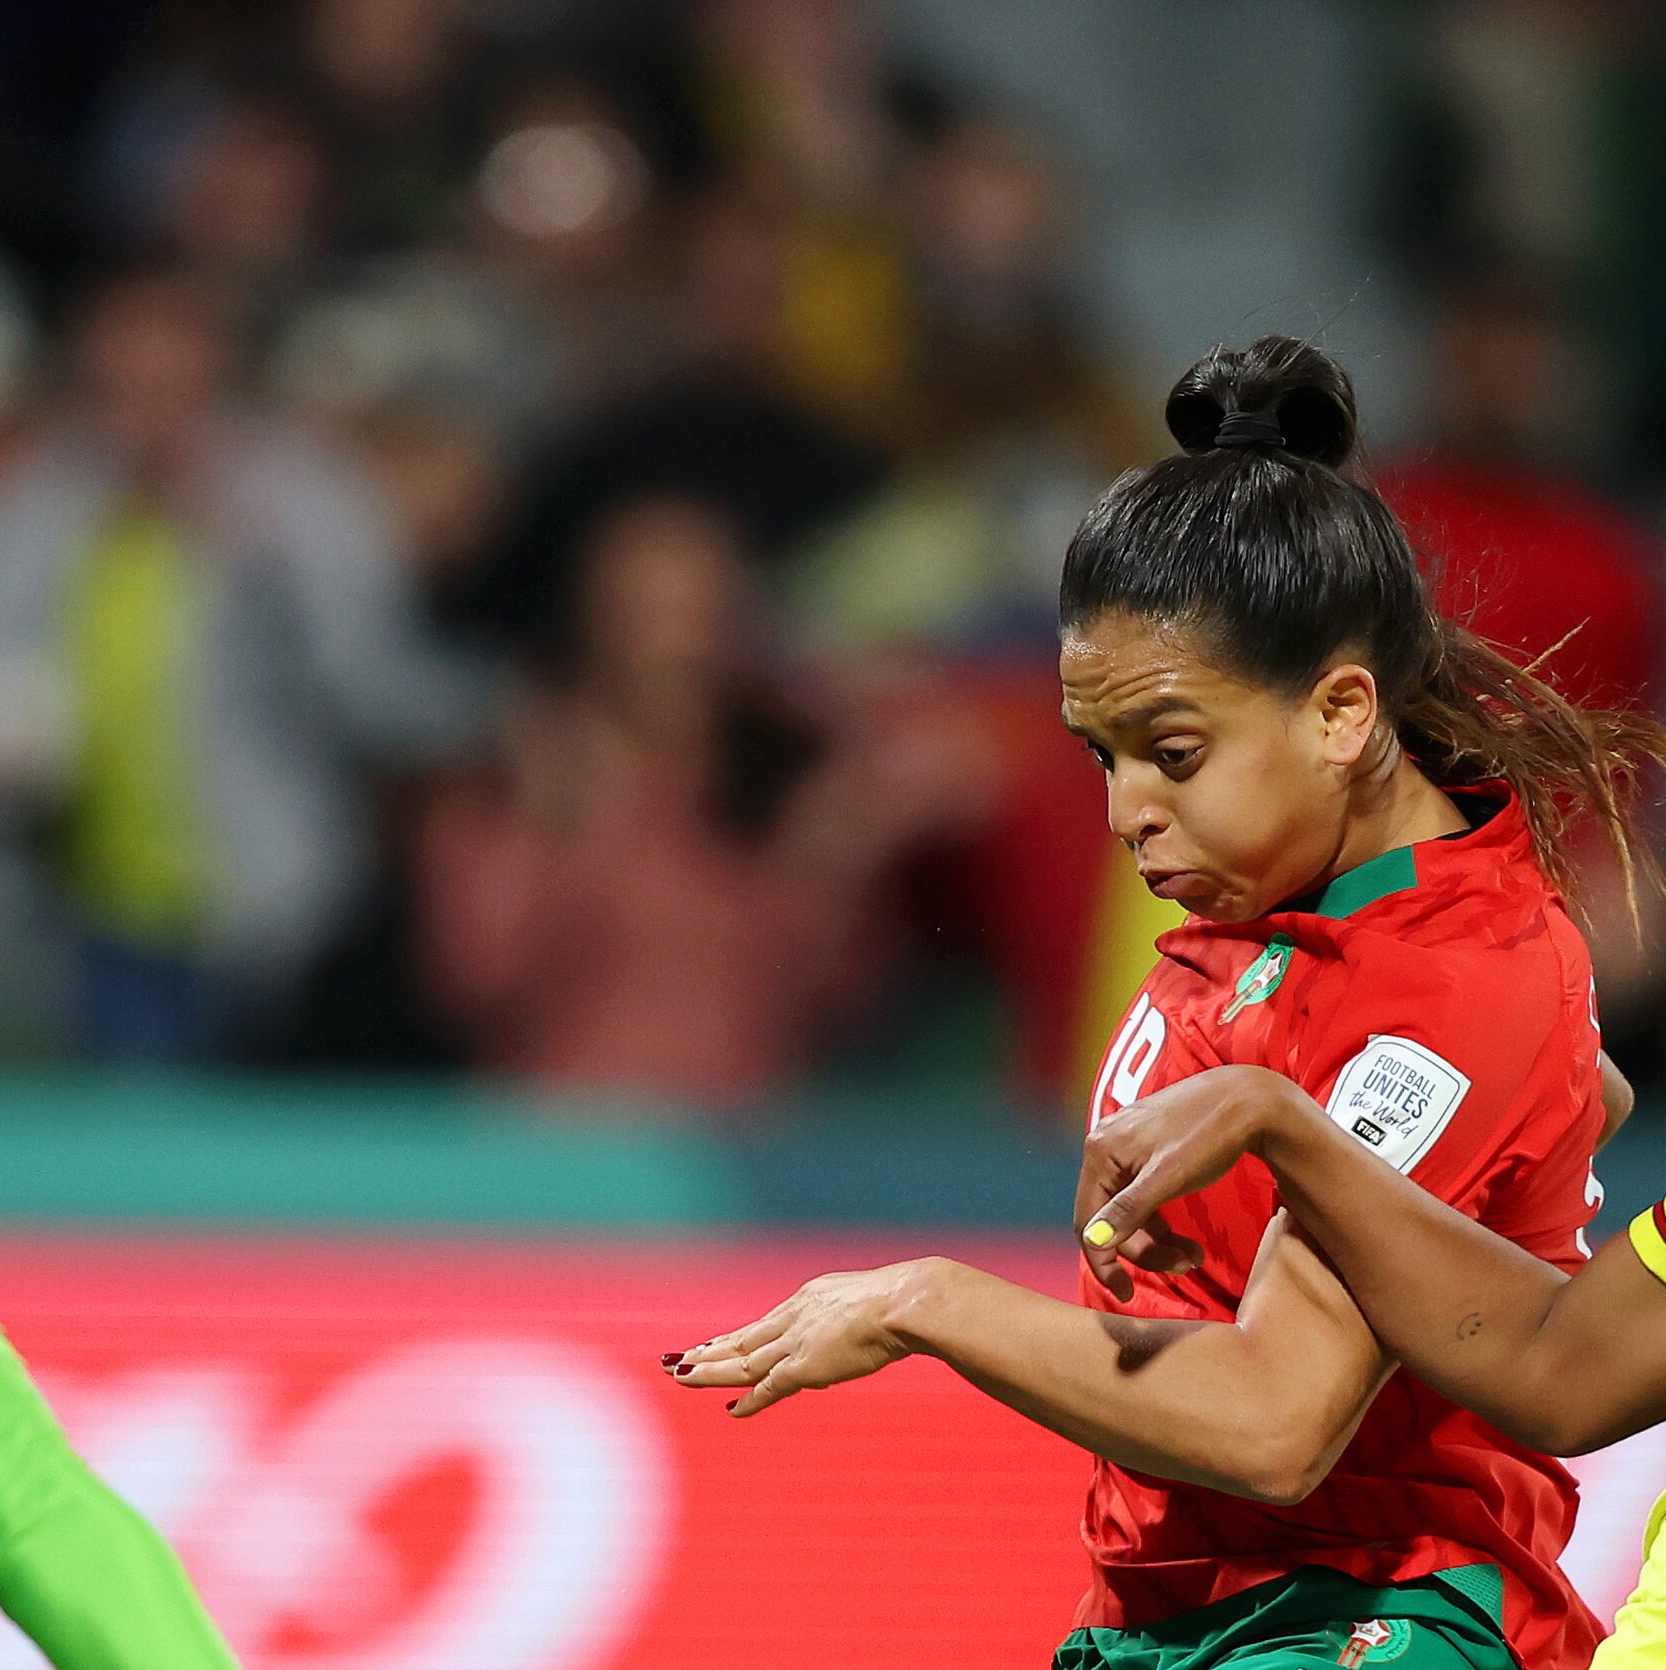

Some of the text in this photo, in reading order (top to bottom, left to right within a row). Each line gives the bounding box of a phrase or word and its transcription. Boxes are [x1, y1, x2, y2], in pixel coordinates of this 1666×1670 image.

[1090, 991, 1166, 1132] 19
[1374, 1054, 1436, 1100] FOOTBALL
[1349, 1090, 1420, 1140] the World
[1362, 1069, 1429, 1119] UNITES
[1355, 1119, 1385, 1145] FIFA
